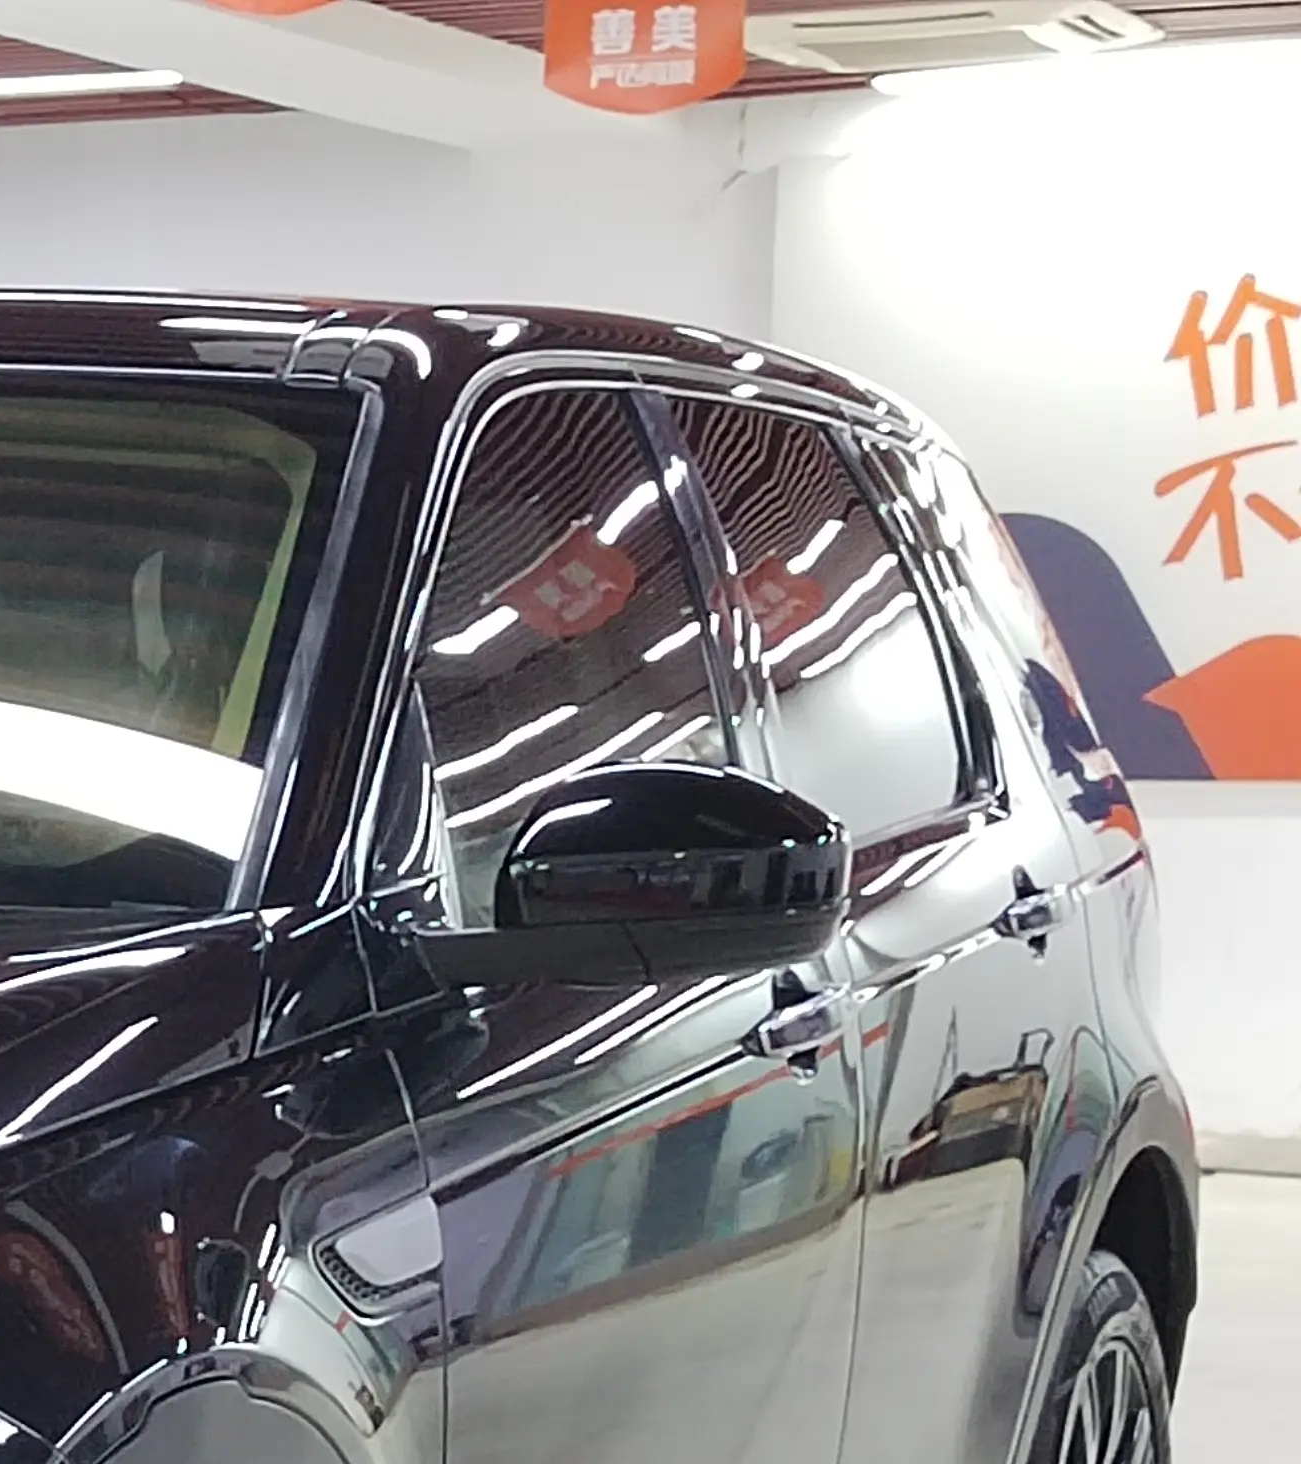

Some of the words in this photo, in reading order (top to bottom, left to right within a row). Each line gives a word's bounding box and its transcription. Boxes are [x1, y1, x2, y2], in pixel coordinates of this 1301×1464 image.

[591, 5, 696, 55] 善美
[1163, 272, 1301, 420] 价
[1154, 438, 1301, 583] 不
